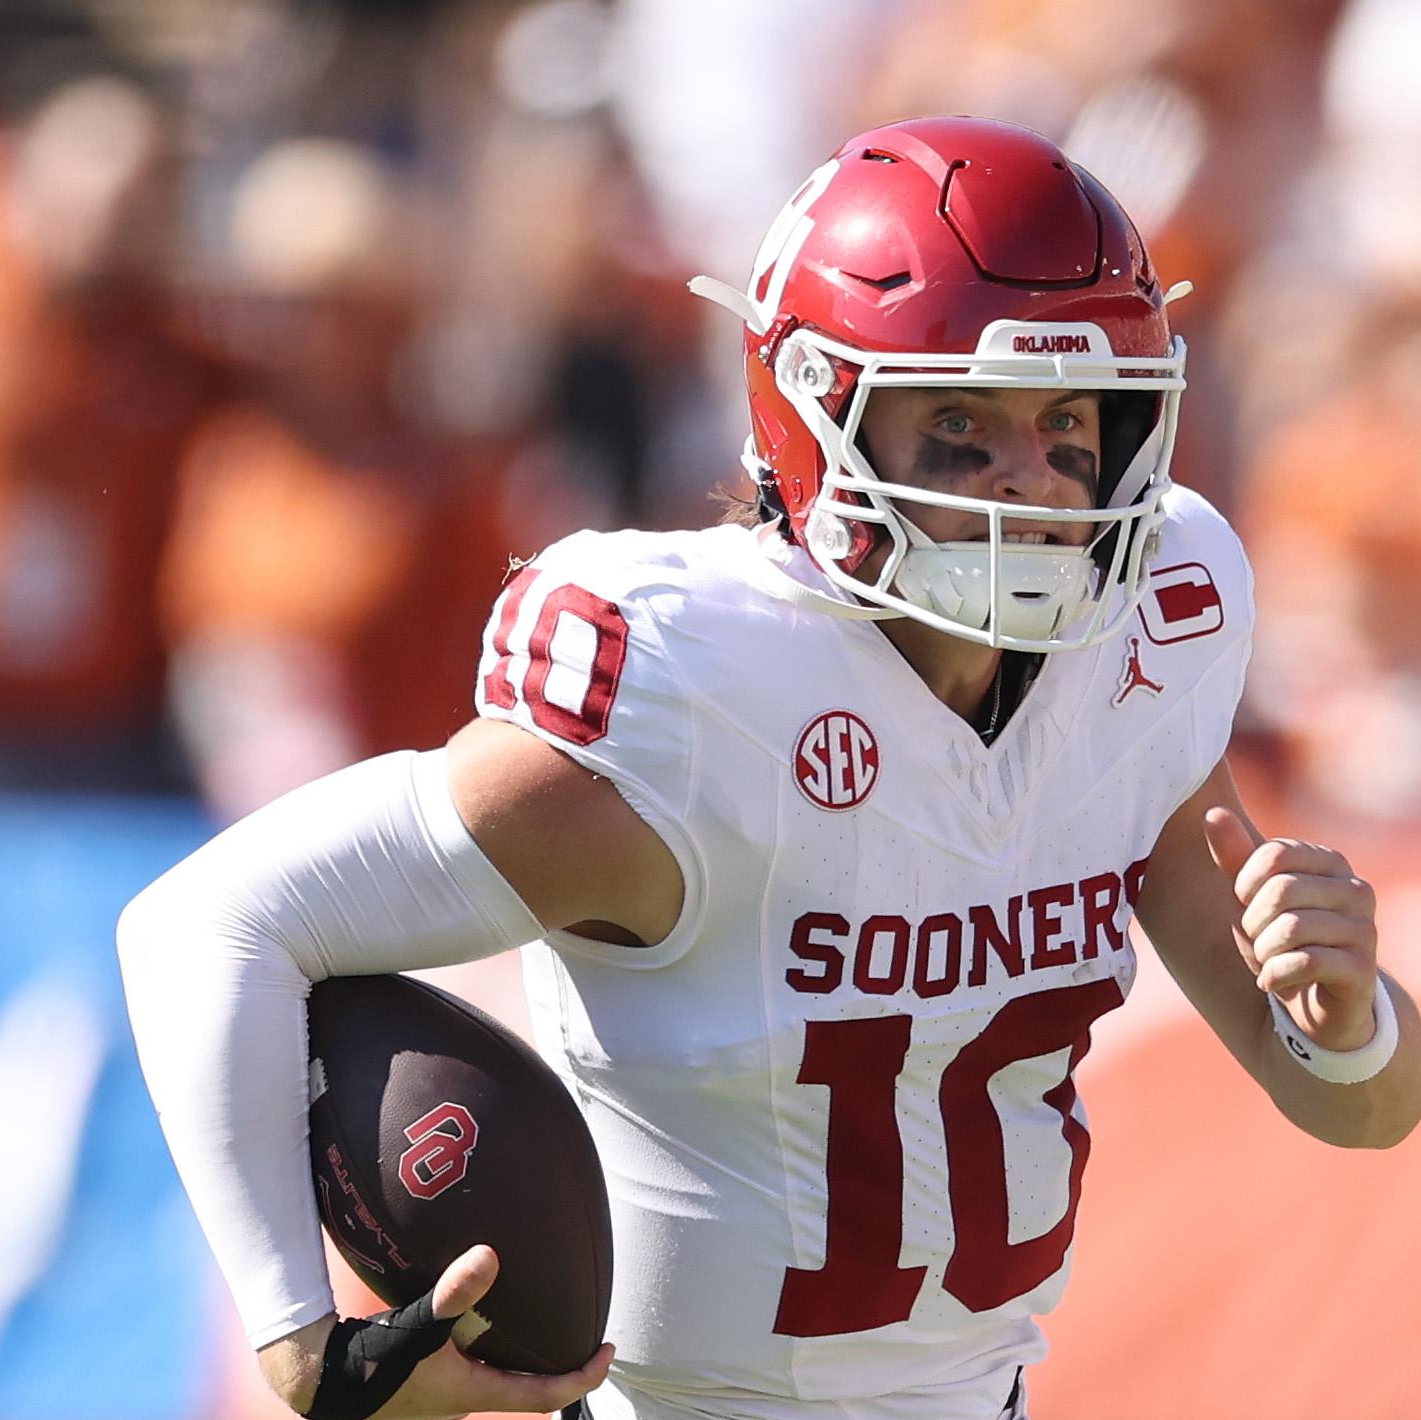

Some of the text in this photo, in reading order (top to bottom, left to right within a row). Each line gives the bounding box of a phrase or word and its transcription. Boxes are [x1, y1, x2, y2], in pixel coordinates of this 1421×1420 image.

[1012, 334, 1092, 353] OKLAHOMA
[483, 567, 630, 747] 10
[799, 716, 876, 804] SEC
[771, 976, 1126, 1338] 10
